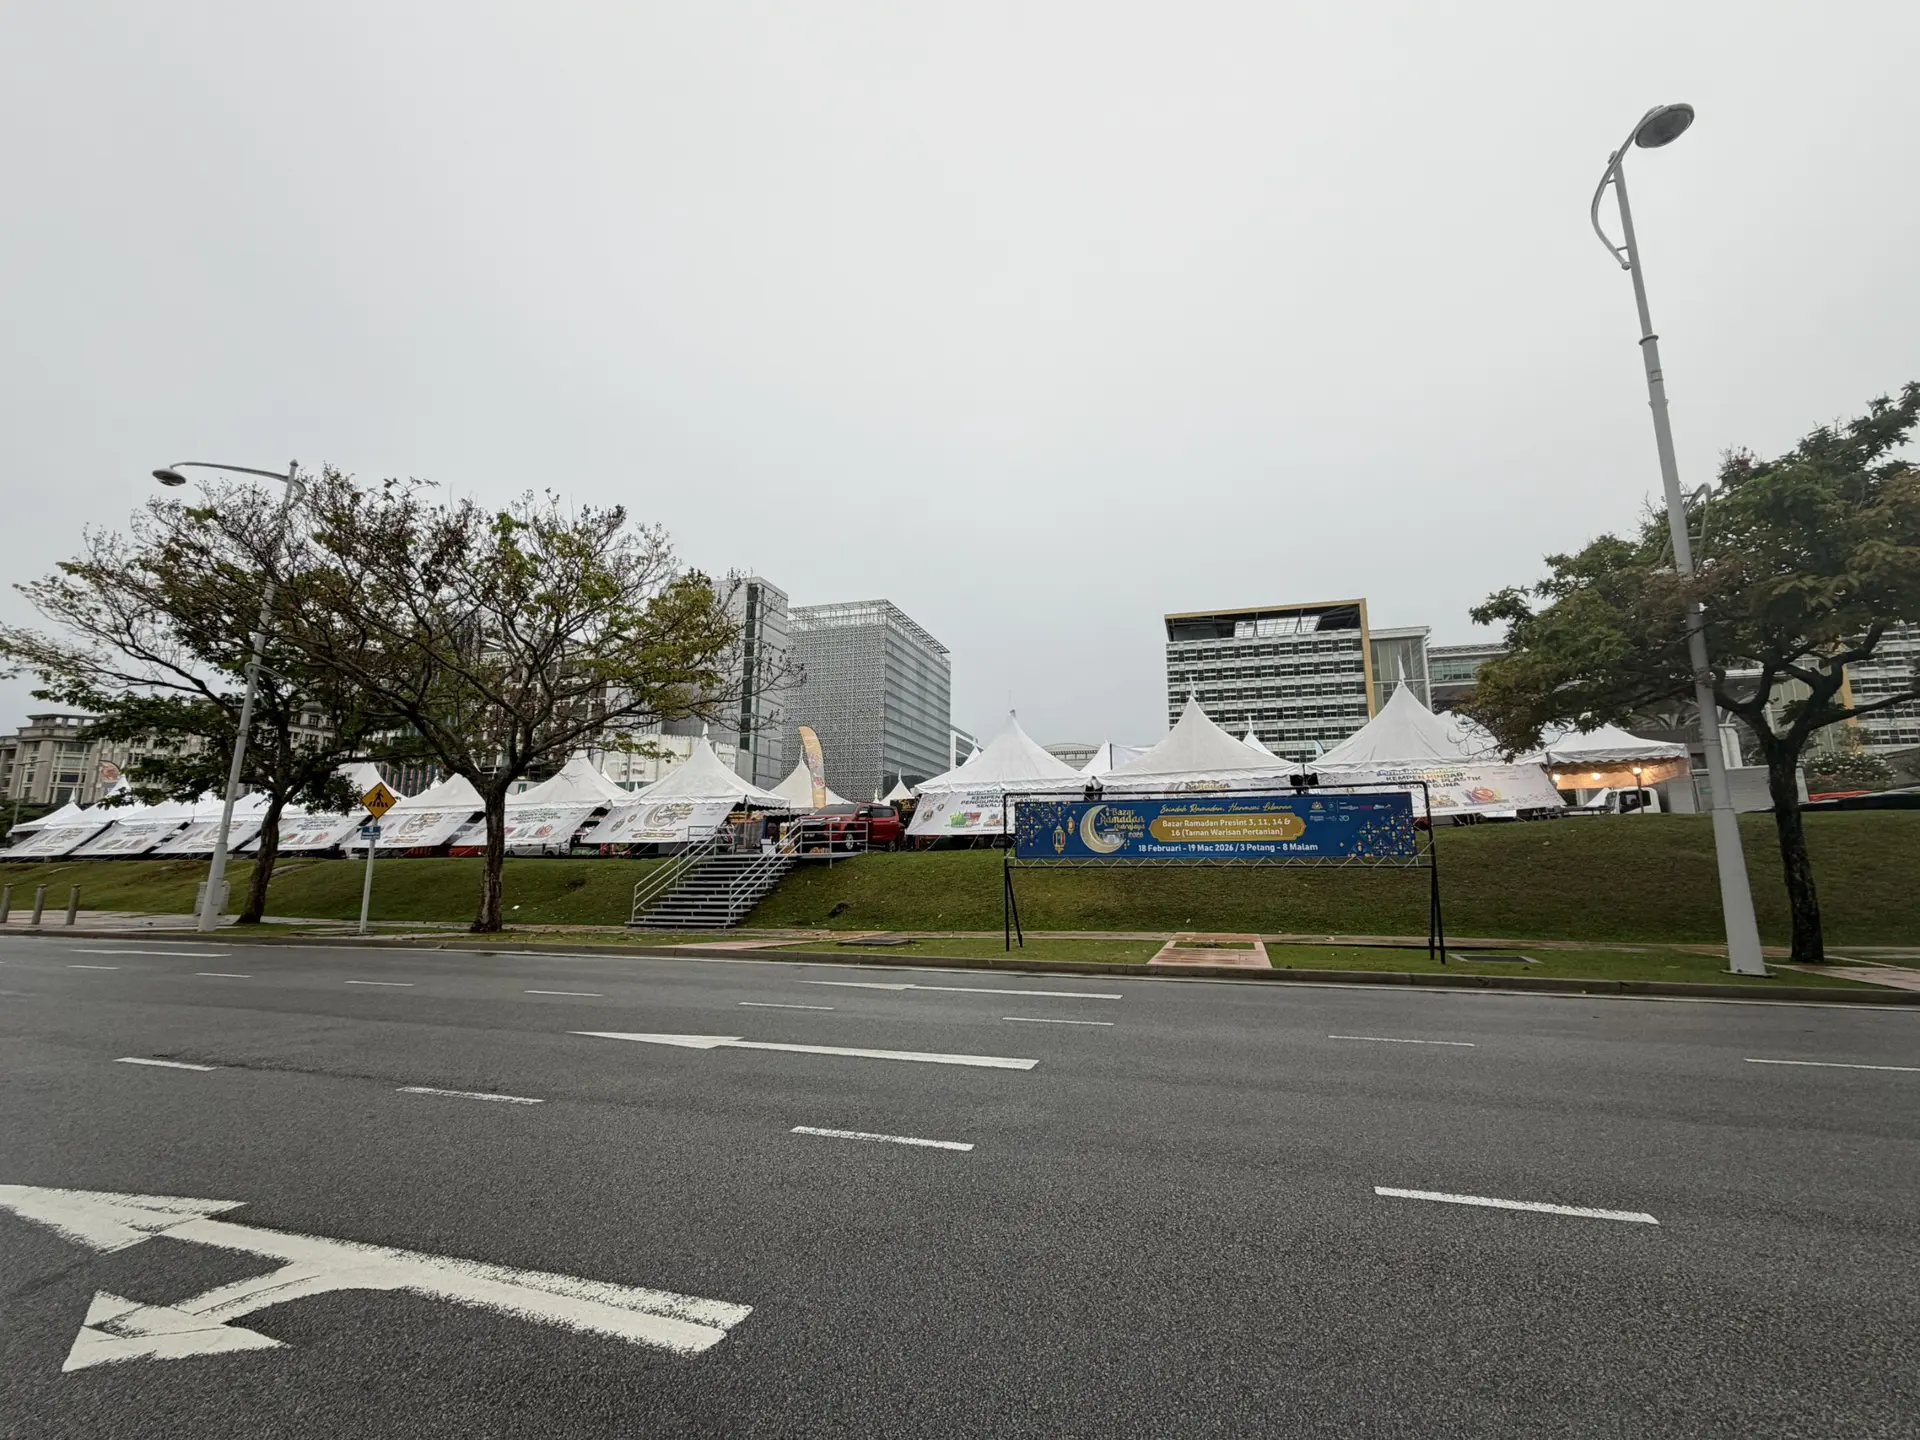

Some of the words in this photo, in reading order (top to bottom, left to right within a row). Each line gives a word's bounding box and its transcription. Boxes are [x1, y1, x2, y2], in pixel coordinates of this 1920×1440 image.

[1111, 808, 1134, 816] Bazar
[1096, 812, 1145, 826] Ramadan
[1184, 819, 1218, 827] Ramadan
[1182, 829, 1209, 837] (Taman
[1210, 828, 1241, 836] Warisan
[1242, 828, 1283, 836] Pertanian)
[1147, 844, 1181, 852] Februari
[1188, 844, 1196, 852] 19
[1246, 844, 1275, 852] Petang
[1289, 843, 1318, 851] Malam
